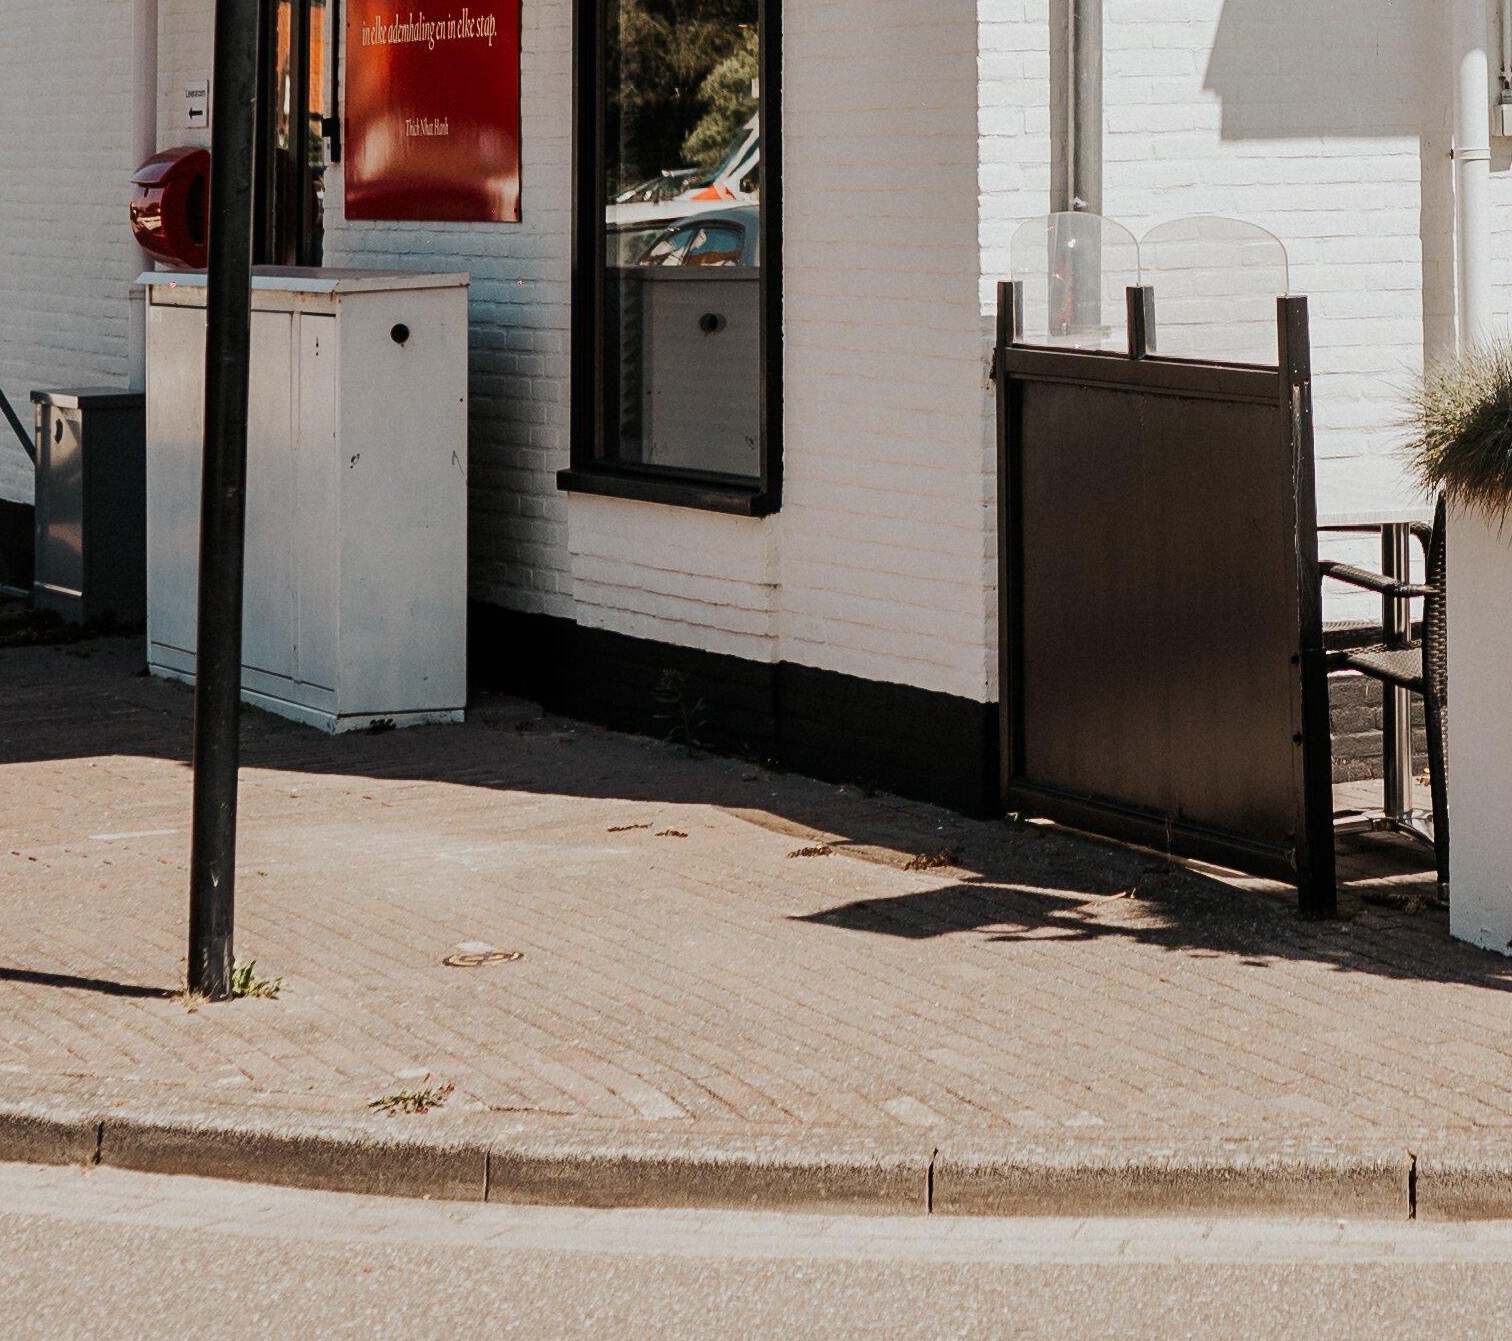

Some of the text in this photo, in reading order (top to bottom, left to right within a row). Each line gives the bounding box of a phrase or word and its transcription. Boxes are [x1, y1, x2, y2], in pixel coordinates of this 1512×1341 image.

[362, 8, 497, 50] in elke ademhaling en in elke stap.
